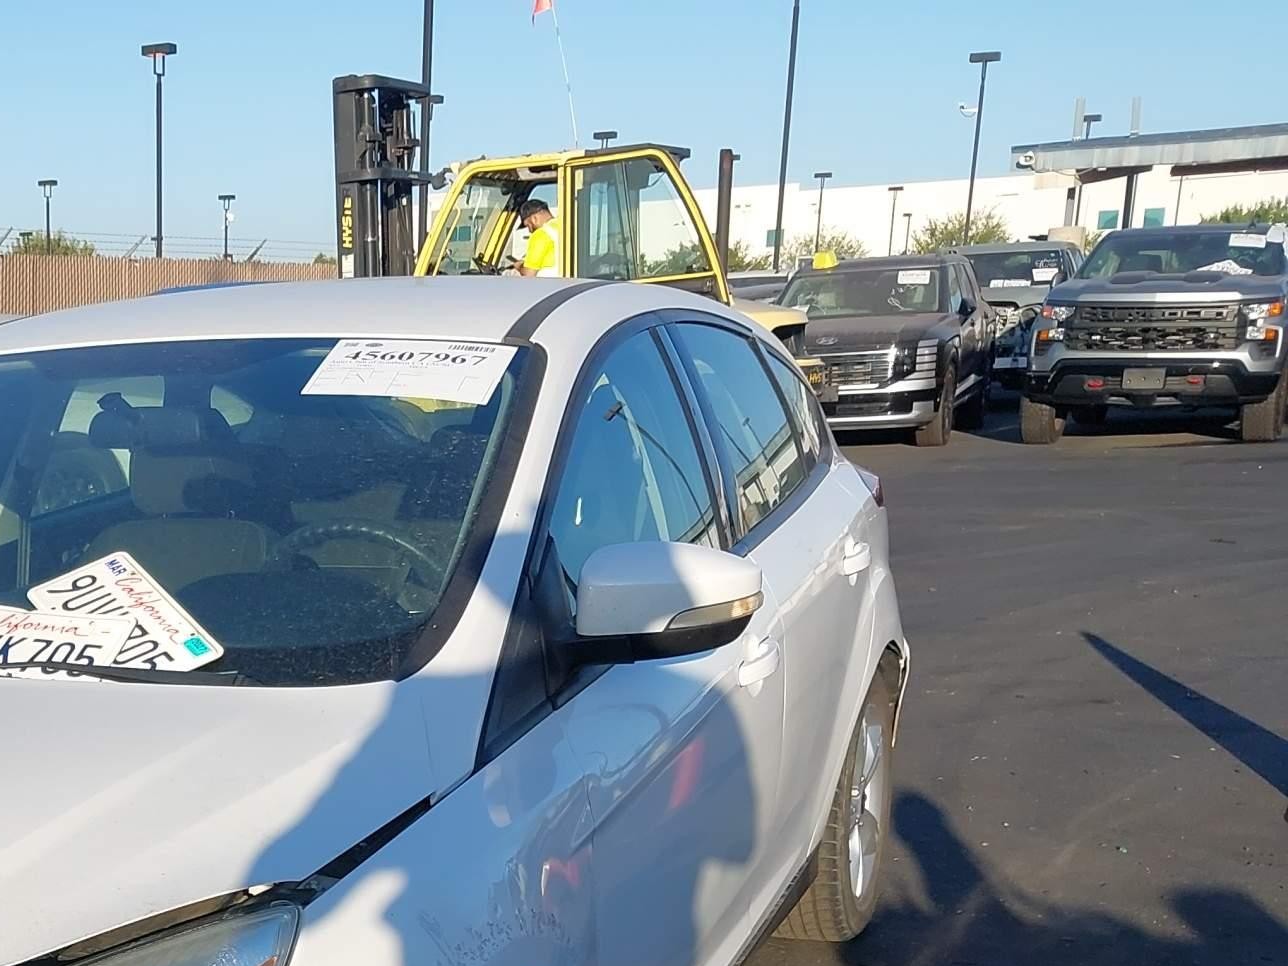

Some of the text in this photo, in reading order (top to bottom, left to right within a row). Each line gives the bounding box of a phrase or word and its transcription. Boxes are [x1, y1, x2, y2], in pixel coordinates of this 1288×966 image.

[344, 350, 489, 366] 45607967
[104, 559, 128, 576] MAR
[114, 576, 180, 646] California
